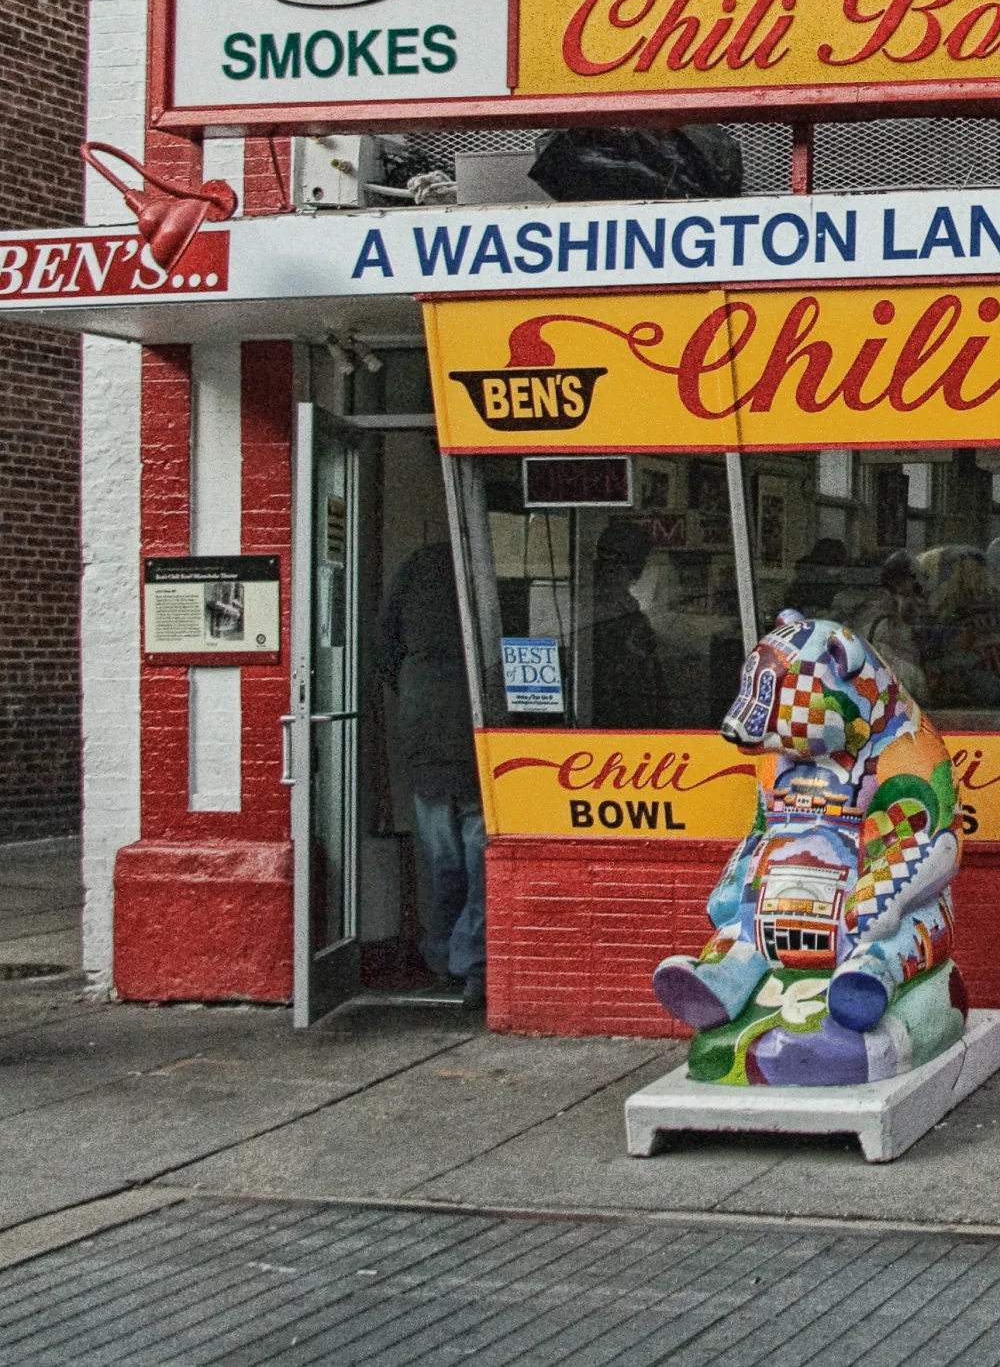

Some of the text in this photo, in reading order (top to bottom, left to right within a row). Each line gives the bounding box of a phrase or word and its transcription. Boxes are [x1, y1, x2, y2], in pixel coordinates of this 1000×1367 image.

[222, 24, 457, 80] SMOKES
[351, 228, 394, 278] A
[413, 210, 857, 276] WASHINGTON
[483, 375, 585, 419] BEN'S
[504, 647, 556, 664] BEST
[521, 665, 560, 684] D.C.
[557, 749, 692, 791] Chili
[570, 800, 687, 831] BOWL
